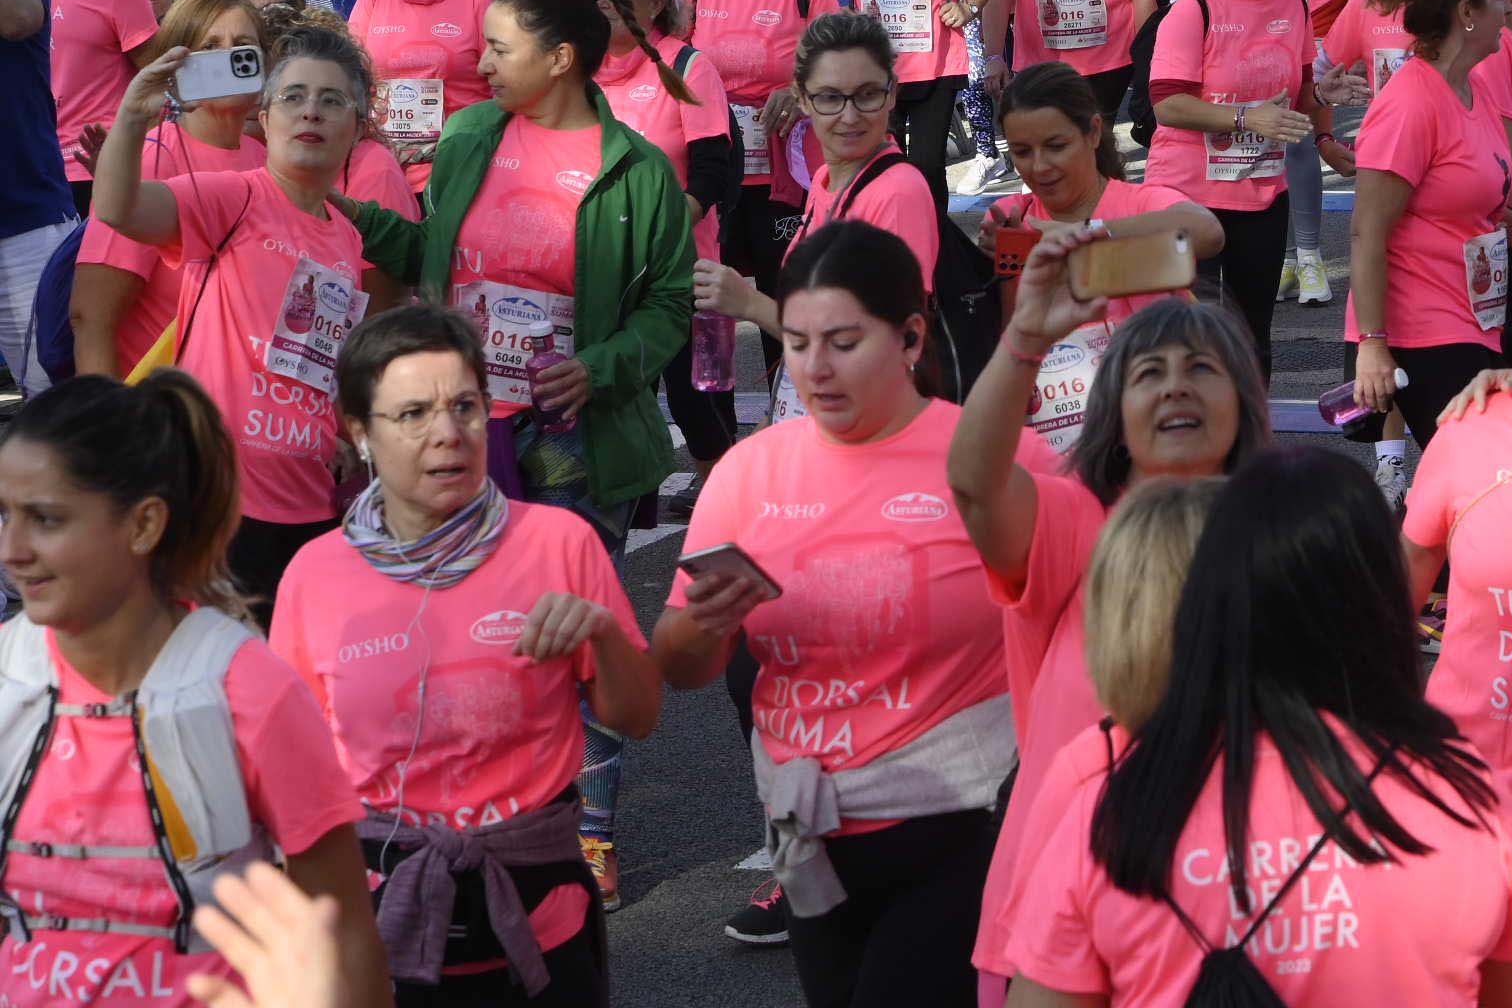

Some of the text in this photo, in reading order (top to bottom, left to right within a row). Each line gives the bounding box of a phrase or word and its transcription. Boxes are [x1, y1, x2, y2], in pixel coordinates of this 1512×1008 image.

[883, 13, 907, 23] 016
[1060, 10, 1085, 20] 016
[389, 108, 415, 120] 016
[454, 245, 484, 274] TU
[497, 306, 544, 322] ASTURIANA
[314, 314, 343, 341] 016
[490, 330, 535, 353] 016
[494, 351, 523, 366] 6049
[1043, 377, 1086, 400] 016
[1054, 399, 1081, 414] 6038
[1058, 416, 1079, 428] DE LA
[337, 630, 410, 664] OYSHO
[755, 635, 799, 666] TU
[1301, 874, 1353, 912] LA
